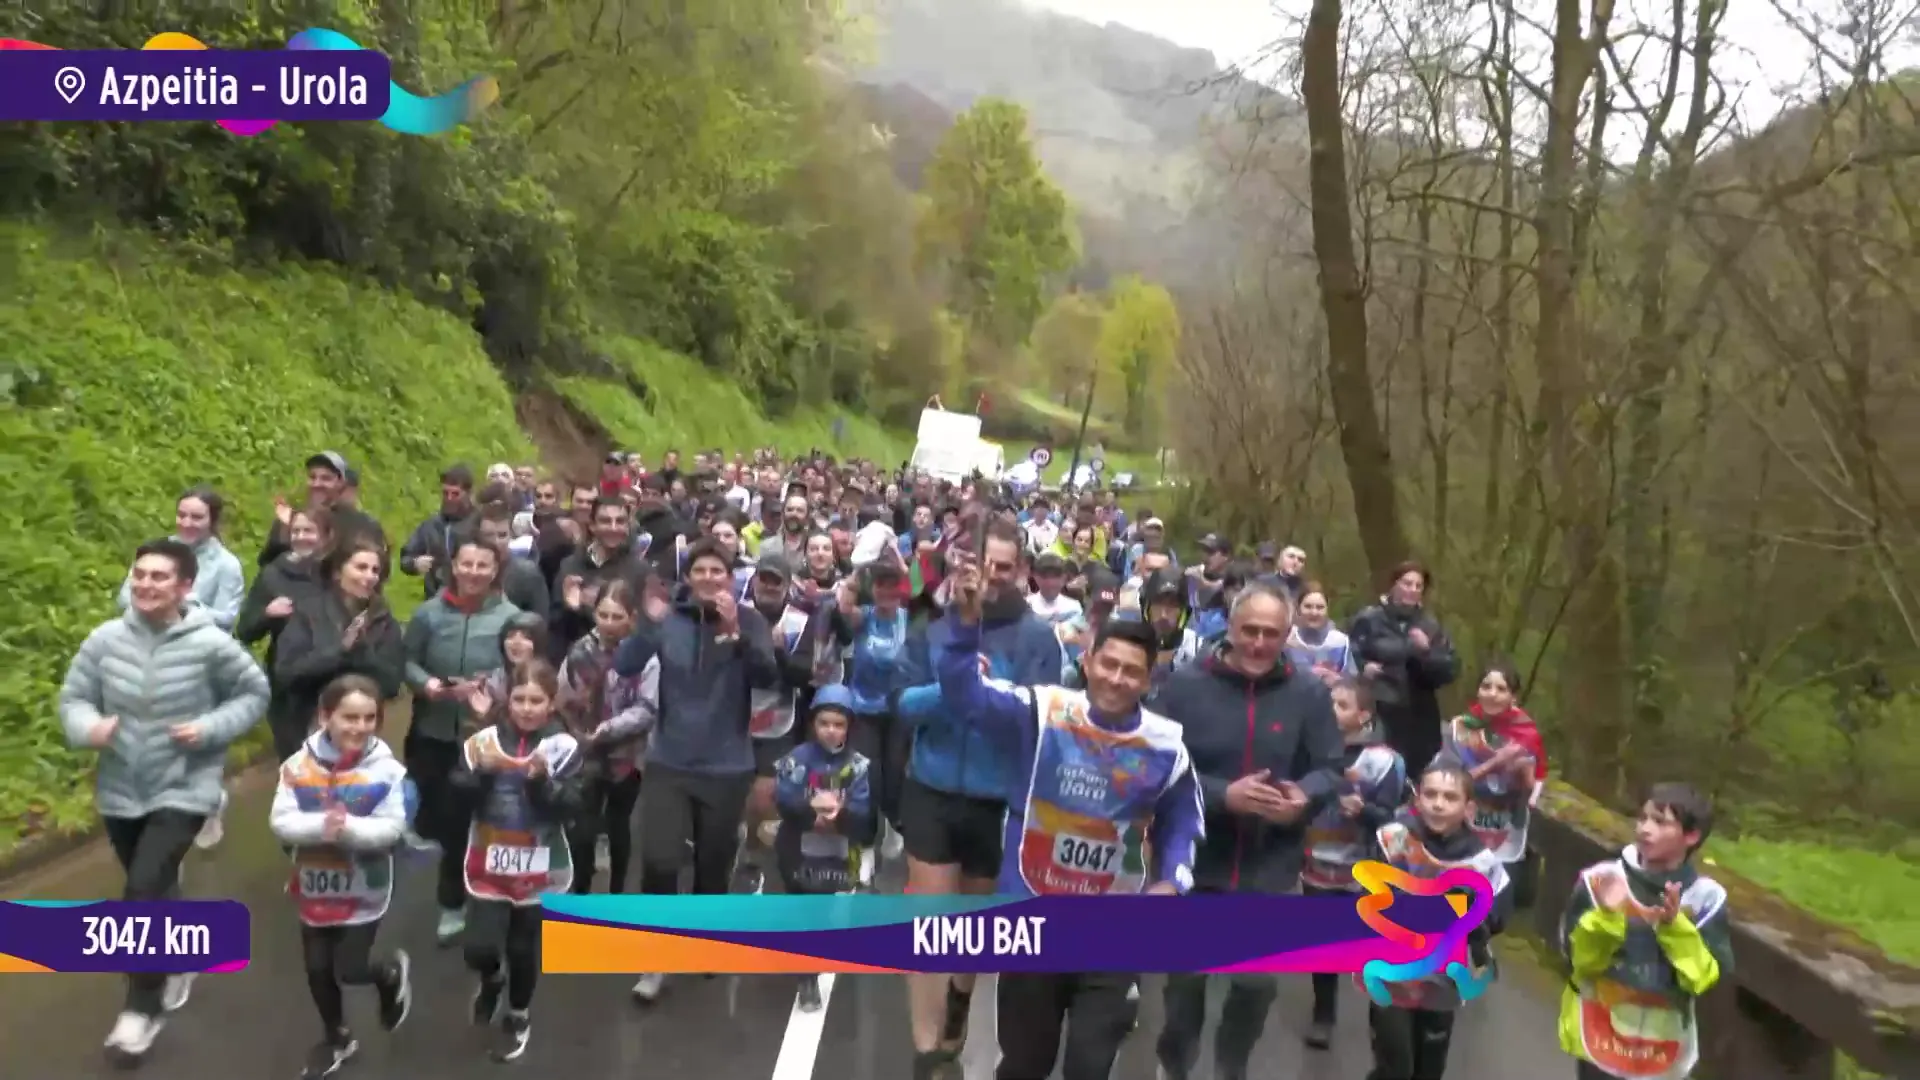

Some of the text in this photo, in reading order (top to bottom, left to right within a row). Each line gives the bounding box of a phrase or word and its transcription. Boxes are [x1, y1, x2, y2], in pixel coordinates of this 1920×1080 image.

[490, 846, 535, 872] 3047
[1060, 838, 1116, 872] 3047
[305, 869, 351, 893] 3047
